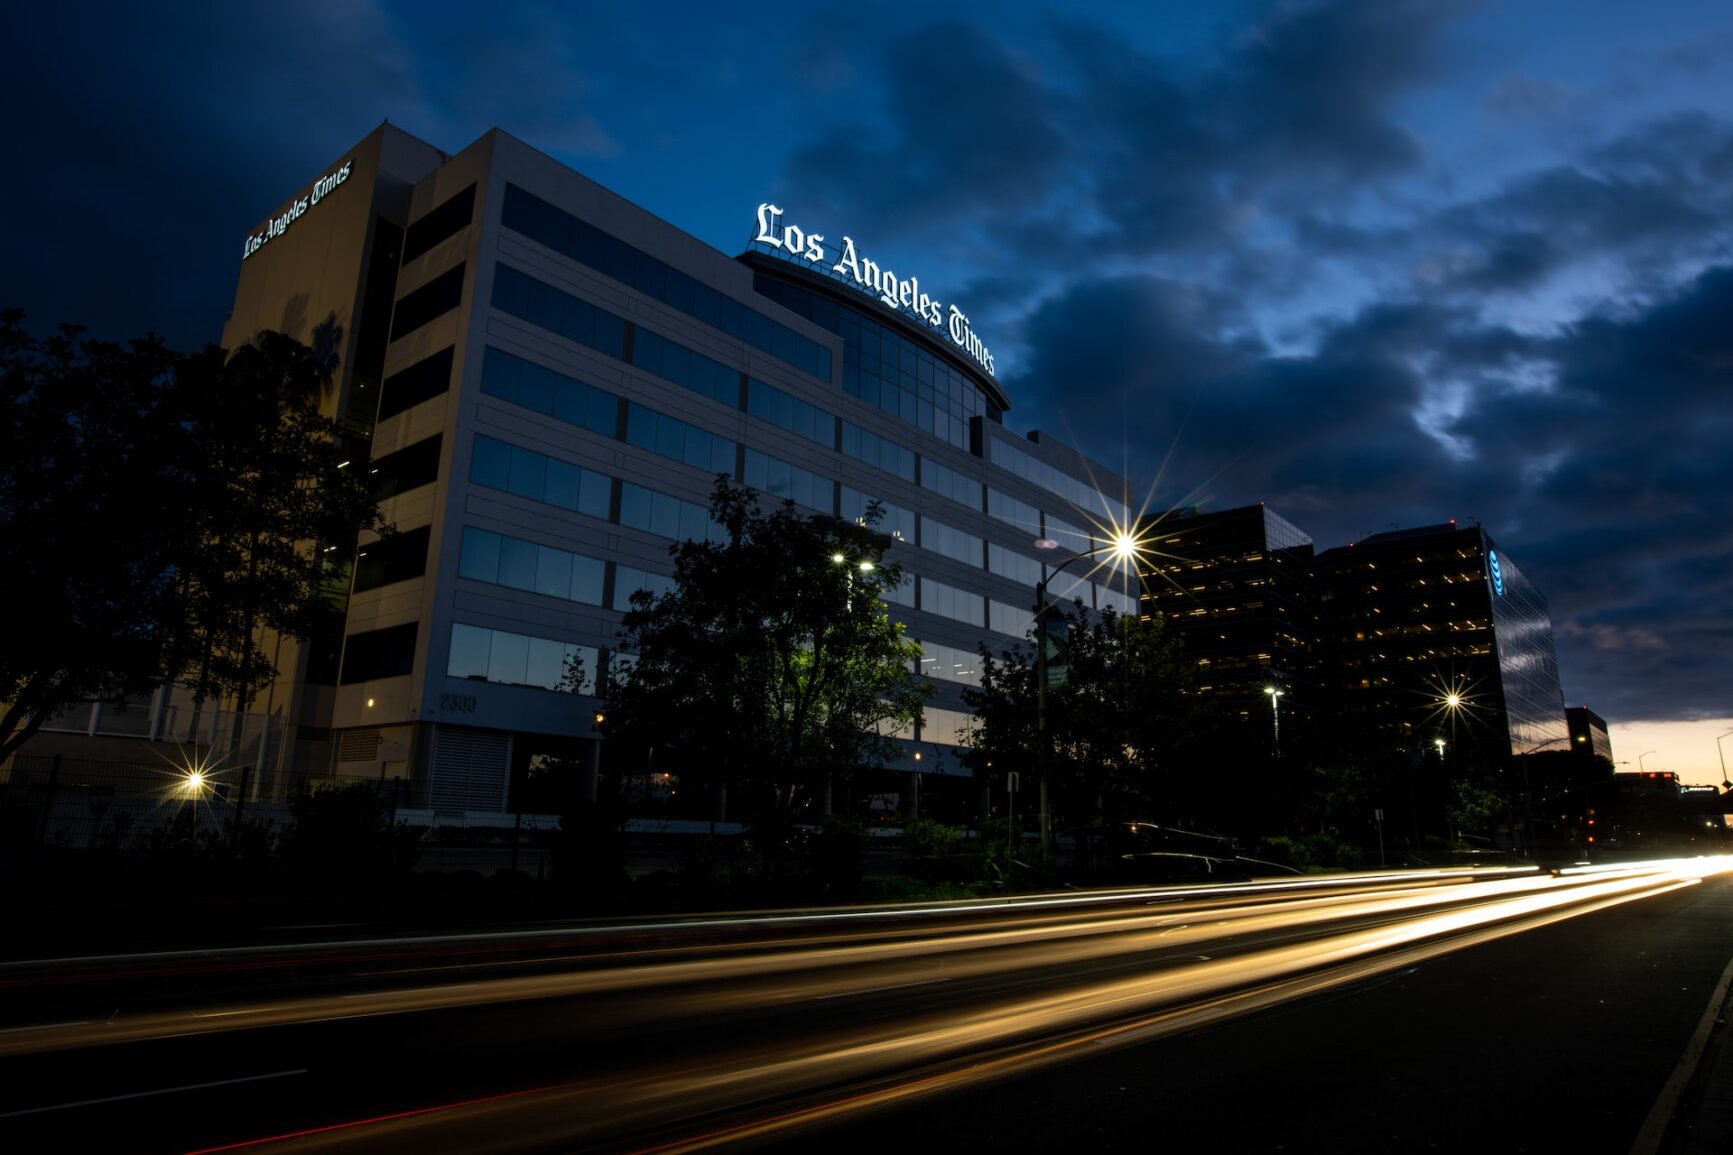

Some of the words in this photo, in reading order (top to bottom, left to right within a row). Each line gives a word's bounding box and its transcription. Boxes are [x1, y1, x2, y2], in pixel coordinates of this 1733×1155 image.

[243, 232, 263, 260] Los
[263, 196, 308, 244] Angeles
[311, 160, 352, 205] Times
[756, 203, 824, 262] Los
[833, 236, 943, 326] Angeles
[948, 304, 995, 376] Times
[440, 692, 476, 712] 2300
